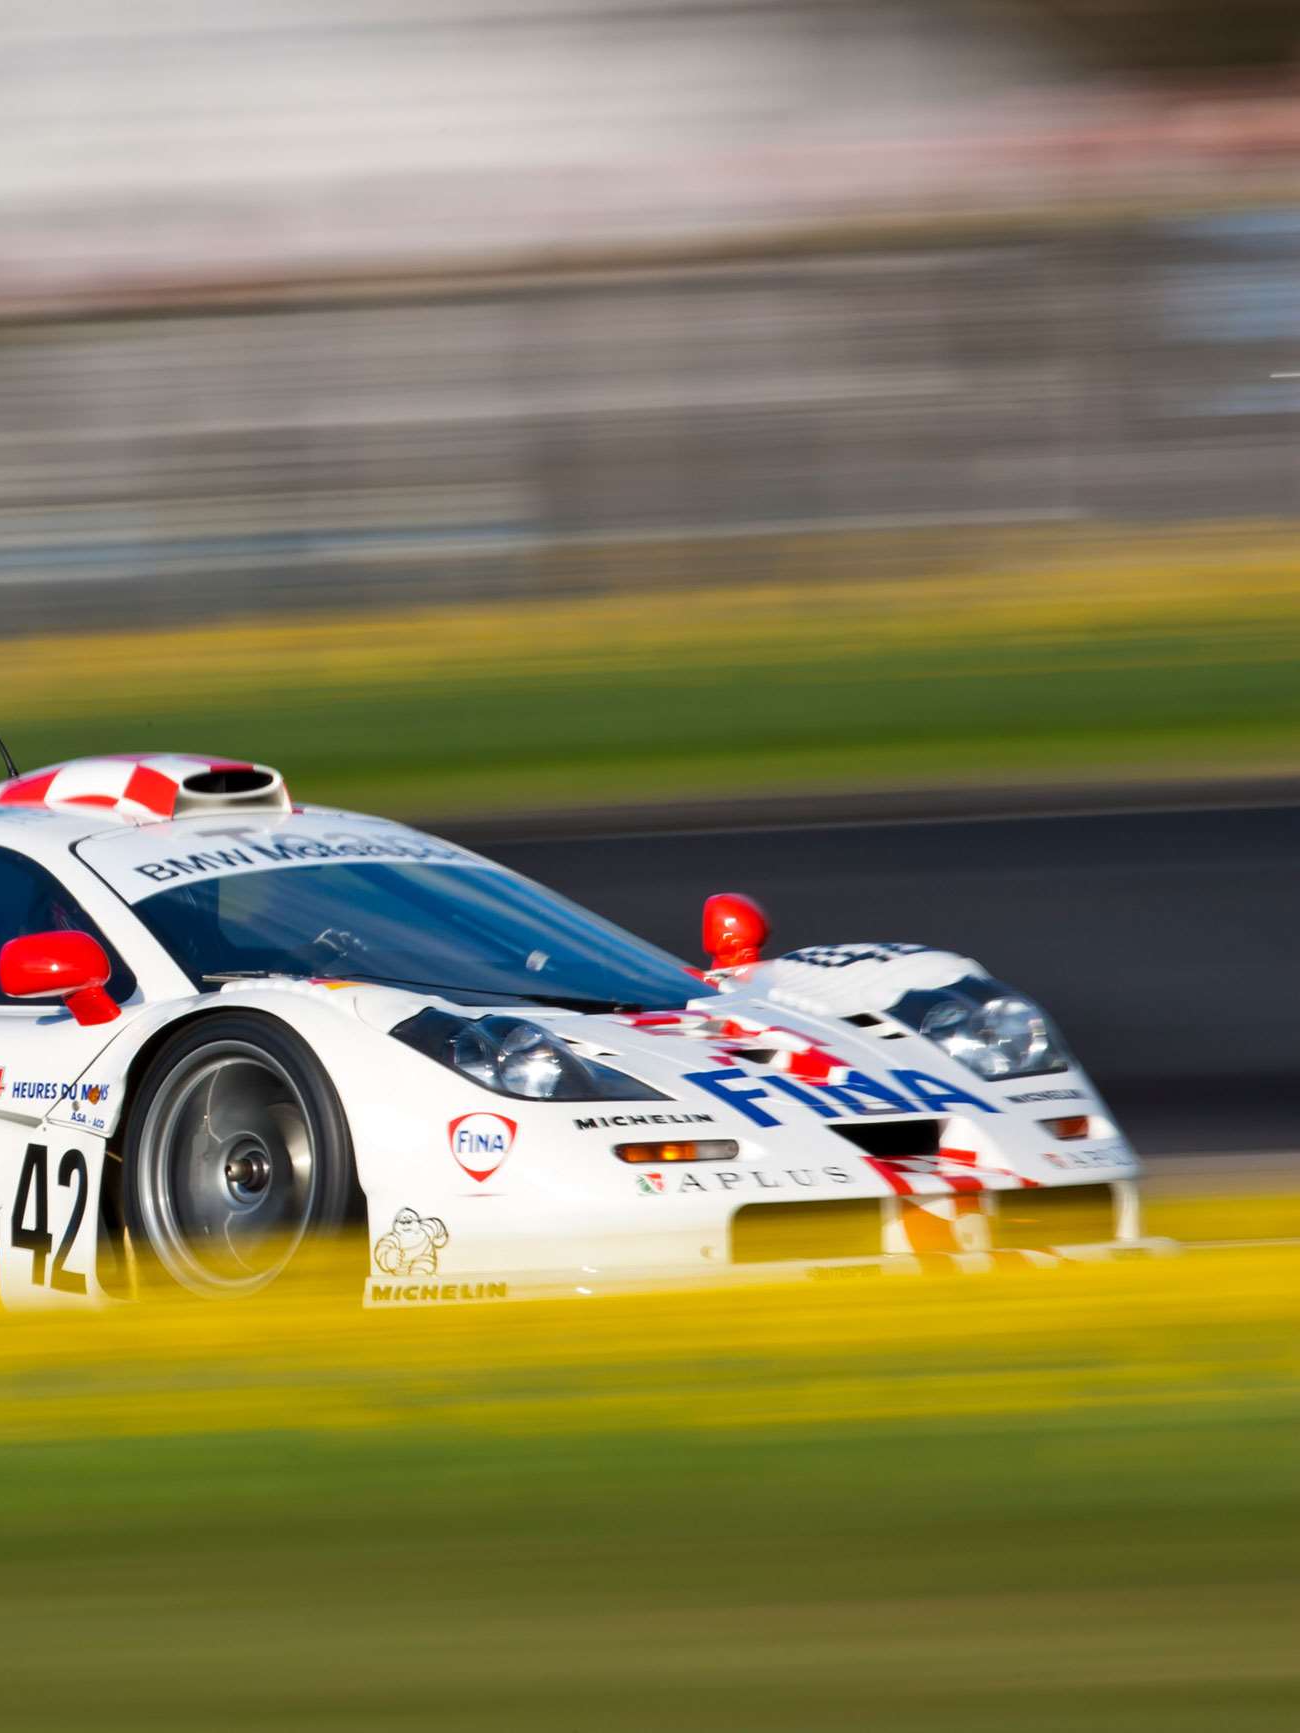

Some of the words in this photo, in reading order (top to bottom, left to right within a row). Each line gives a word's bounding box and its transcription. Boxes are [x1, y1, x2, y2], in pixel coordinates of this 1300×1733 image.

[134, 848, 254, 883] BMW
[12, 1081, 57, 1099] HEURES
[61, 1083, 78, 1100] DU
[682, 1067, 1006, 1128] FINA
[573, 1113, 714, 1131] MICHELIN
[457, 1130, 505, 1154] FINA
[677, 1166, 854, 1194] APLUS
[11, 1142, 88, 1294] 42
[371, 1281, 507, 1301] MICHELIN
